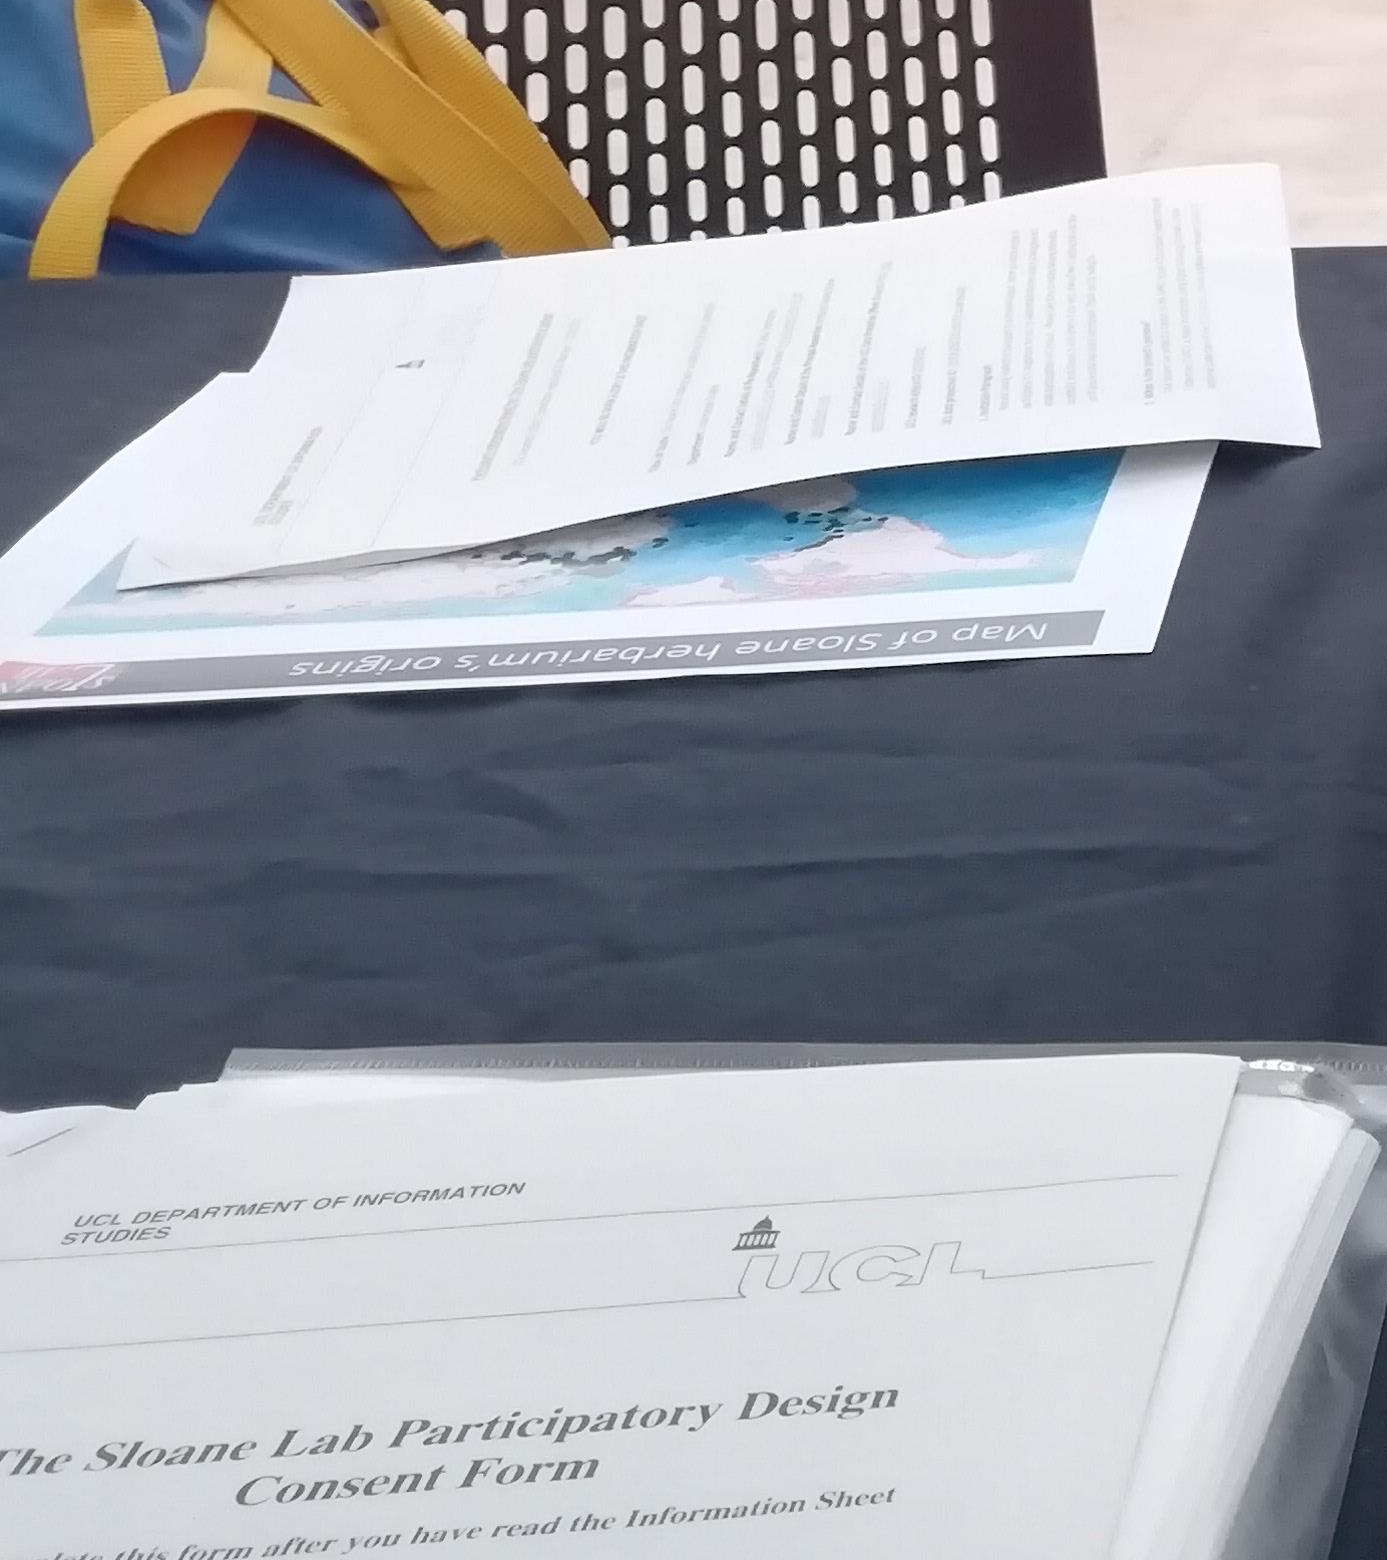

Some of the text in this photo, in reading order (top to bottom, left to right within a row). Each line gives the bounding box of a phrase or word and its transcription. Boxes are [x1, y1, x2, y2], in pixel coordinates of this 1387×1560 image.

[735, 633, 882, 654] Sloane
[888, 630, 937, 650] of
[952, 624, 1046, 642] Map
[289, 655, 441, 677] origins
[74, 1183, 525, 1227] UCL DEPARTMENT OF INFORMATION
[61, 1227, 171, 1245] STUDIES
[737, 1240, 986, 1299] UCL
[84, 1441, 257, 1470] Sloane
[271, 1425, 373, 1458] Lab
[389, 1404, 722, 1448] Participatory
[738, 1386, 898, 1420] Design
[236, 1458, 599, 1505] Consent Form
[261, 1537, 338, 1557] after
[350, 1534, 401, 1550] you
[411, 1527, 482, 1544] have
[491, 1516, 562, 1537] read
[570, 1514, 615, 1532] the
[626, 1498, 805, 1527] Information
[815, 1489, 894, 1509] Sheet
